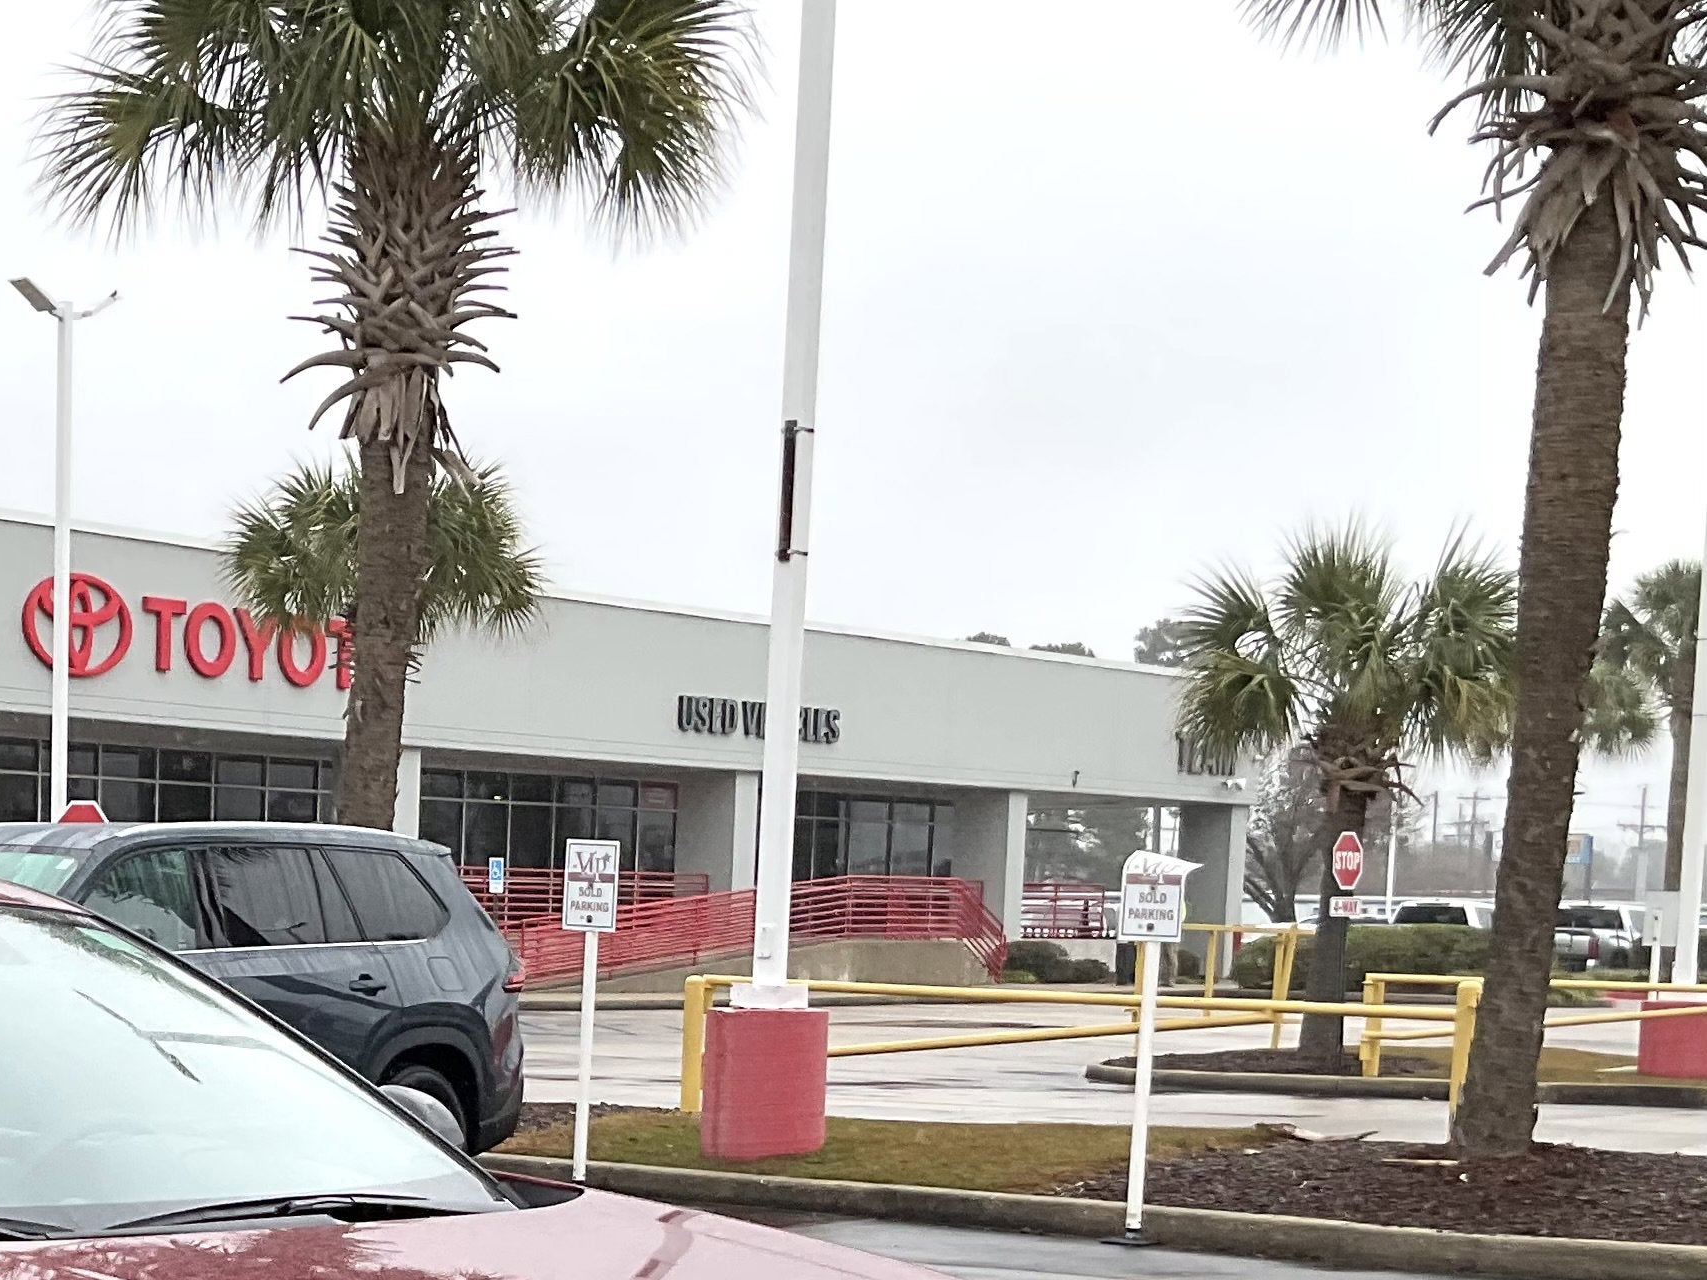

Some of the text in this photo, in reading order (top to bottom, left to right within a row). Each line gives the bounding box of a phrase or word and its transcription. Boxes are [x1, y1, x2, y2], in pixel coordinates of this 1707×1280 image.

[142, 596, 355, 690] TOYOT
[678, 695, 841, 744] USED VECLES
[1335, 851, 1360, 870] STOP
[578, 886, 603, 898] SOLD
[1138, 892, 1167, 904] SOLD
[570, 901, 609, 913] PARKING
[1334, 901, 1359, 913] 4-WAY
[1128, 908, 1174, 921] PARKING
